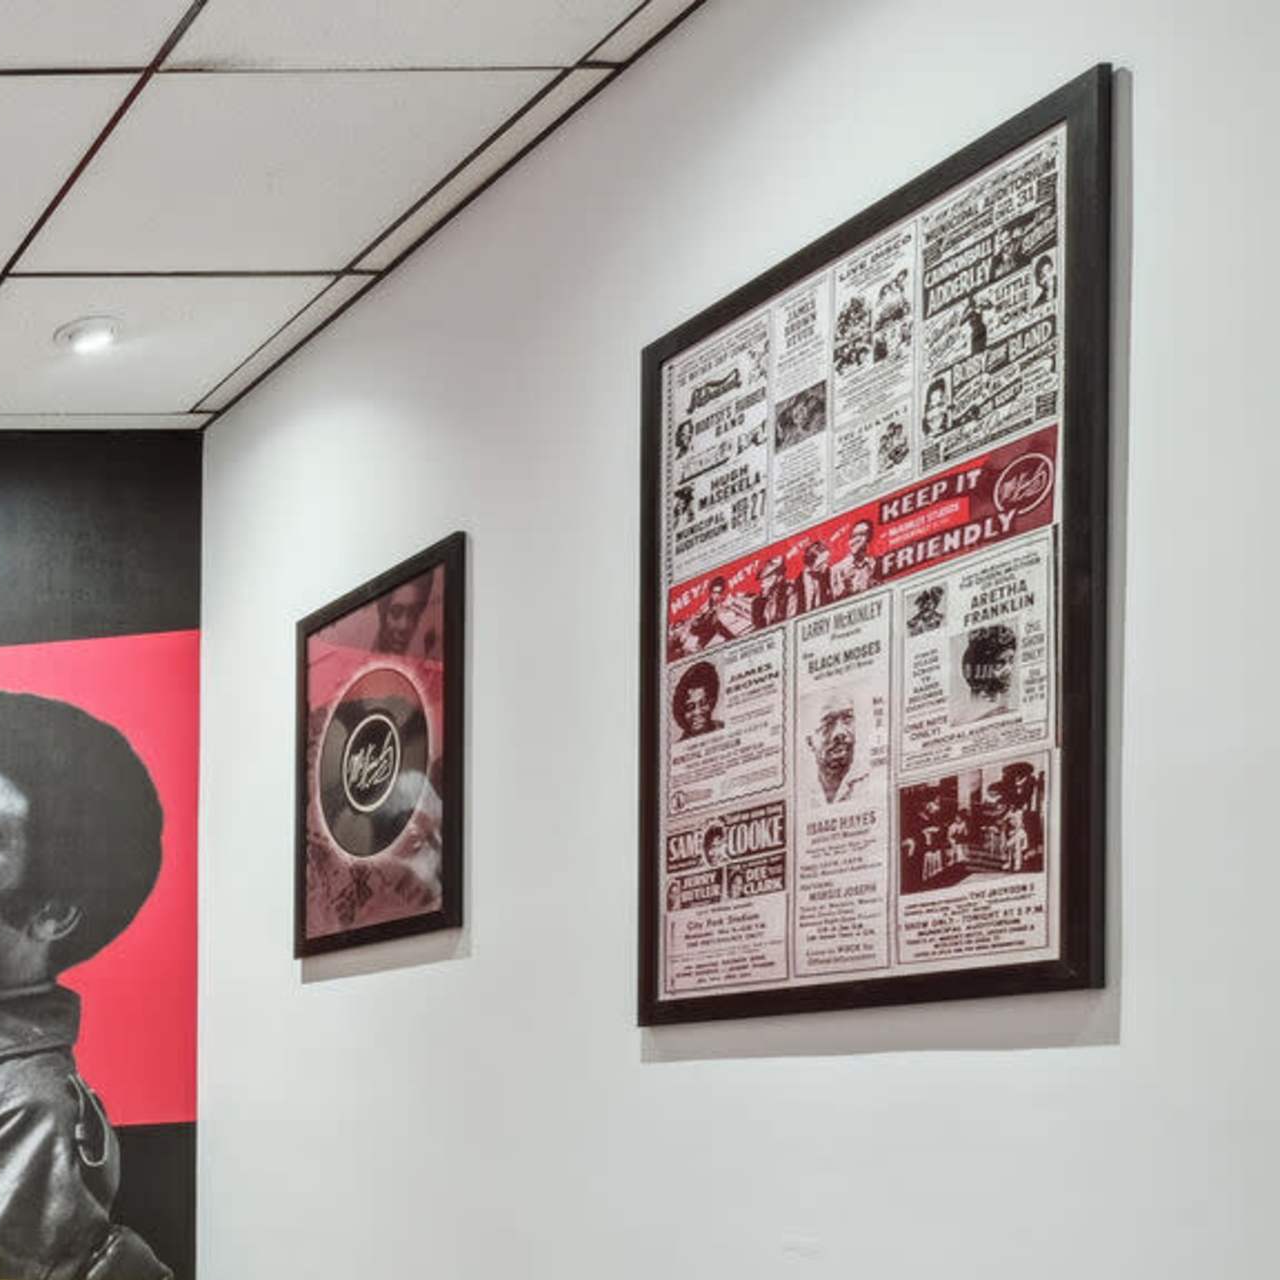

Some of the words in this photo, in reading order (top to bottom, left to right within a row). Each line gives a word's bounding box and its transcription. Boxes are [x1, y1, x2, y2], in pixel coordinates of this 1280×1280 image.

[880, 480, 947, 522] KEEP
[957, 468, 983, 494] IT
[881, 508, 1016, 576] FRIENDLY
[963, 592, 1035, 627] FRANKLIN
[971, 579, 1028, 610] ARETHA
[801, 616, 831, 642] LARRY
[808, 652, 841, 675] BLACK
[842, 639, 881, 663] MOSES
[727, 815, 784, 857] COOKE
